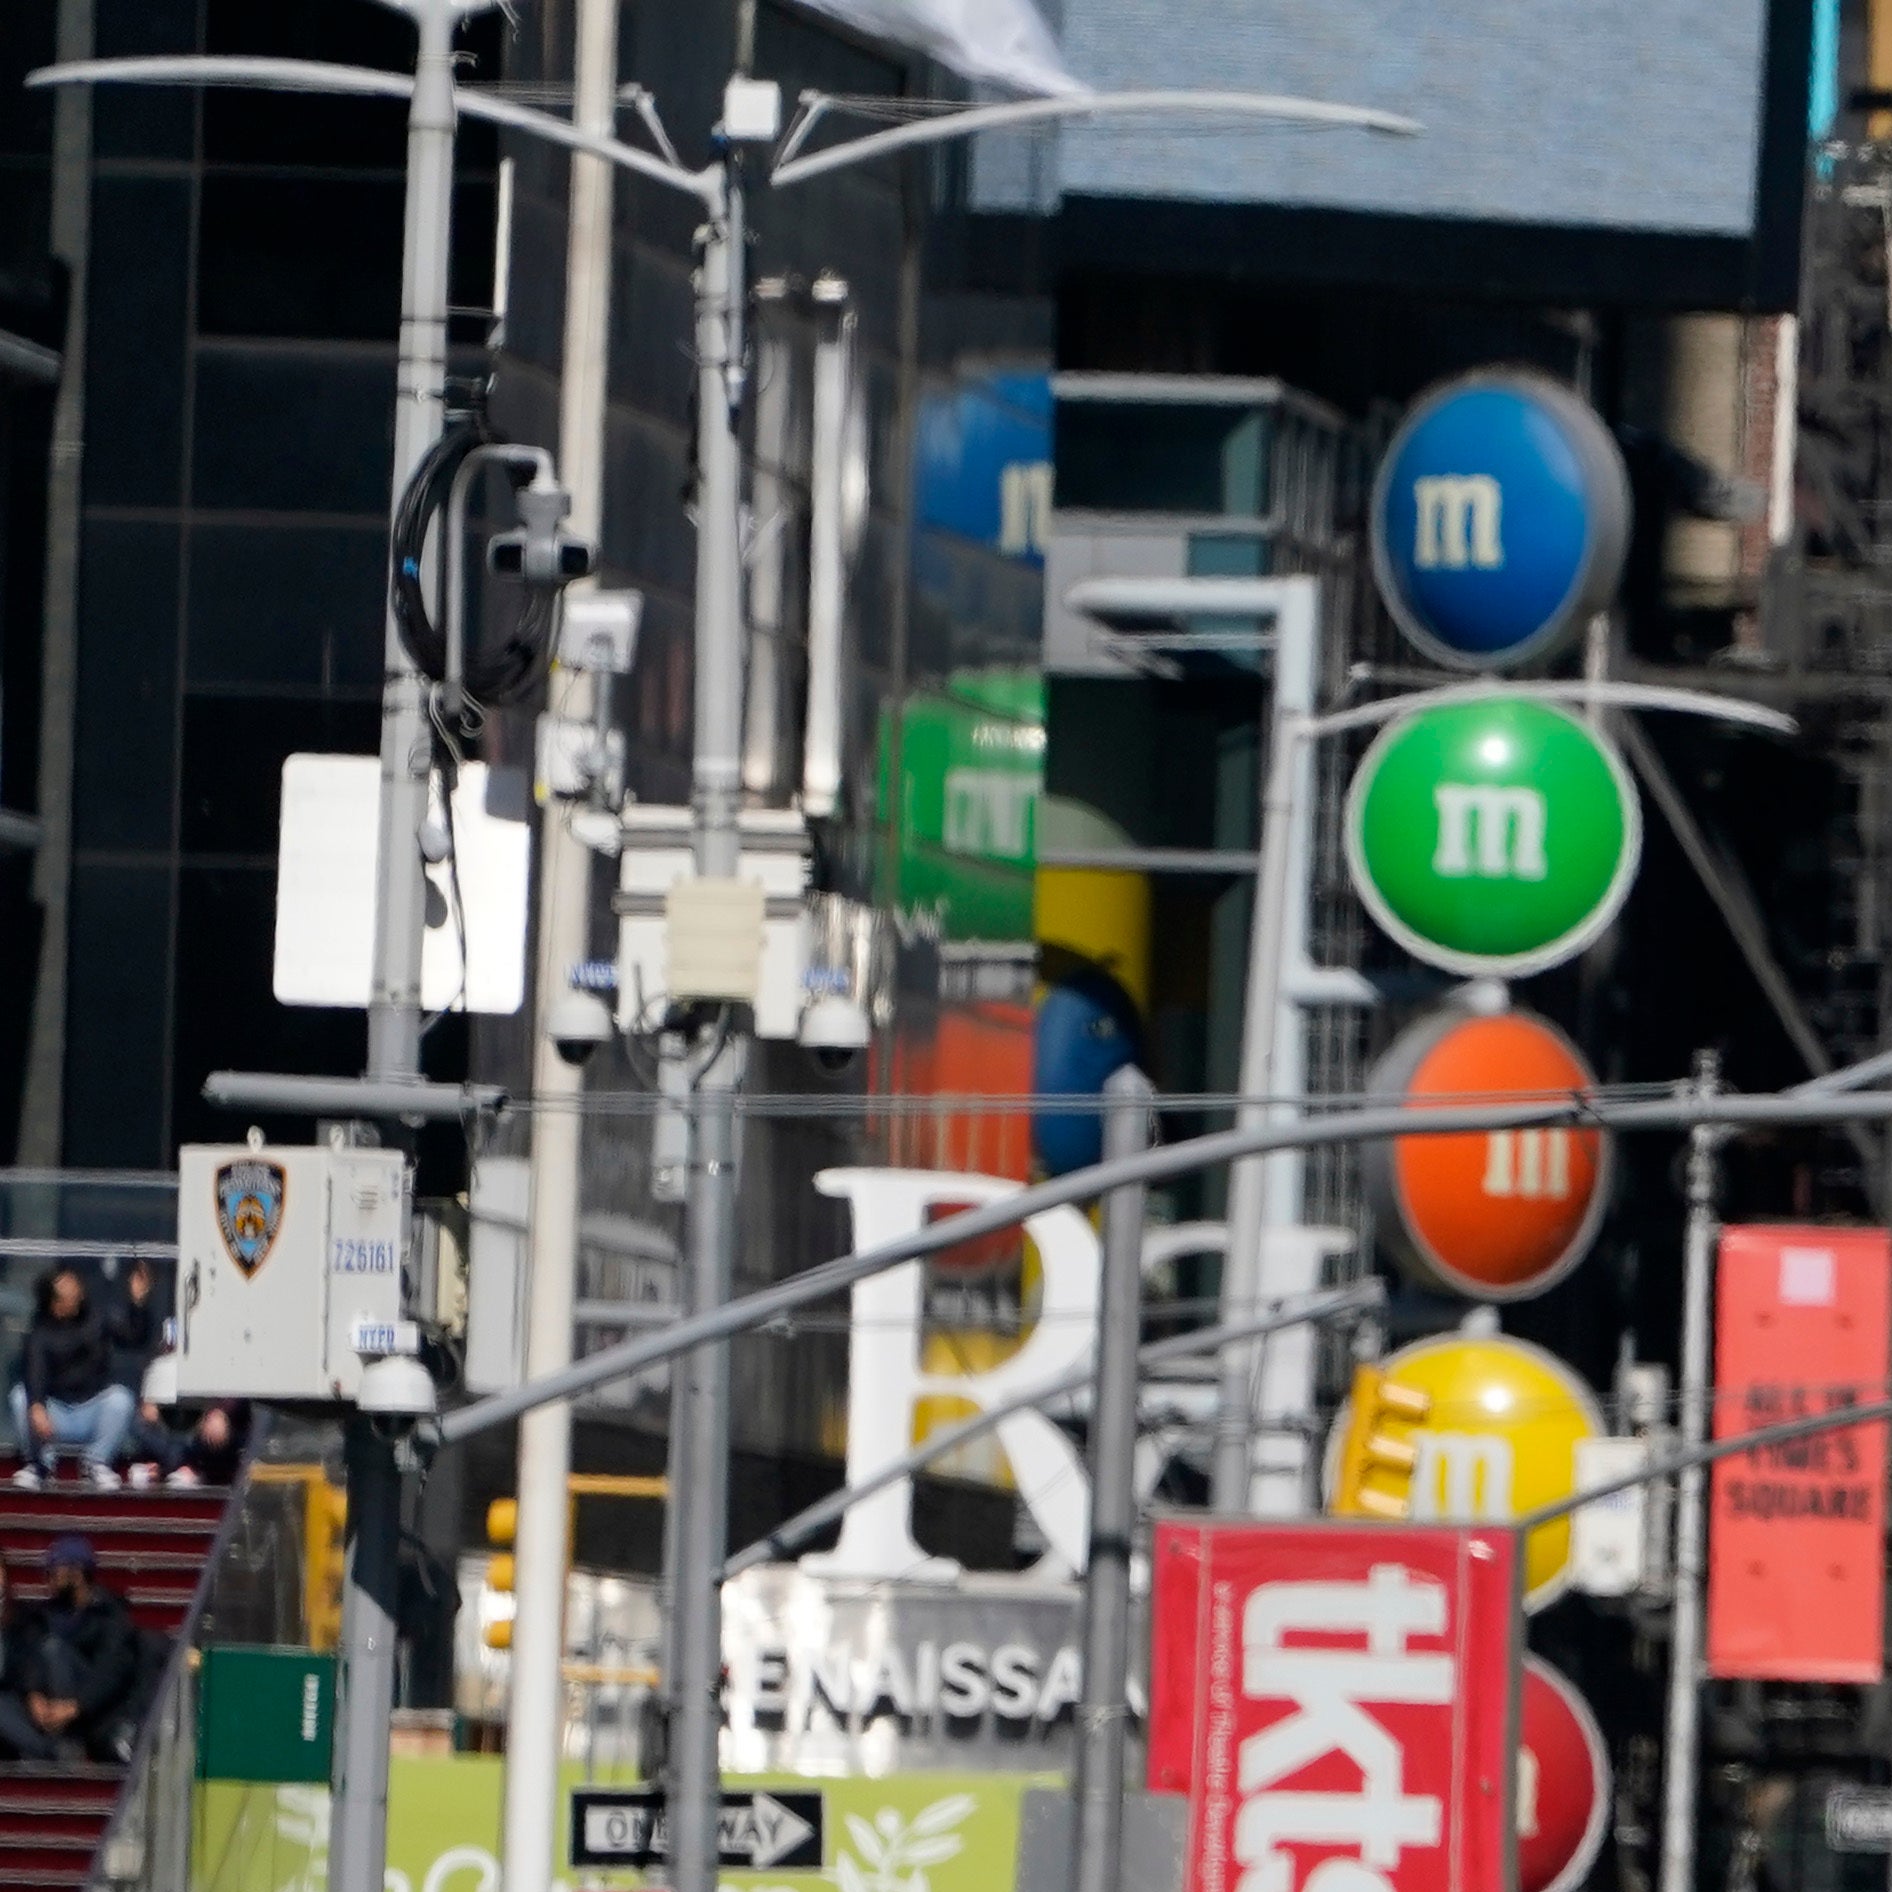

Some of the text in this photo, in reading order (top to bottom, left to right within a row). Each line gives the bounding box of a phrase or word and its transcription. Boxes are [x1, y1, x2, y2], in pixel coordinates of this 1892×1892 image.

[1414, 473, 1505, 572] m
[1434, 782, 1549, 882] m
[800, 1165, 1104, 1584] R
[748, 1640, 1083, 1722] ENAISSA
